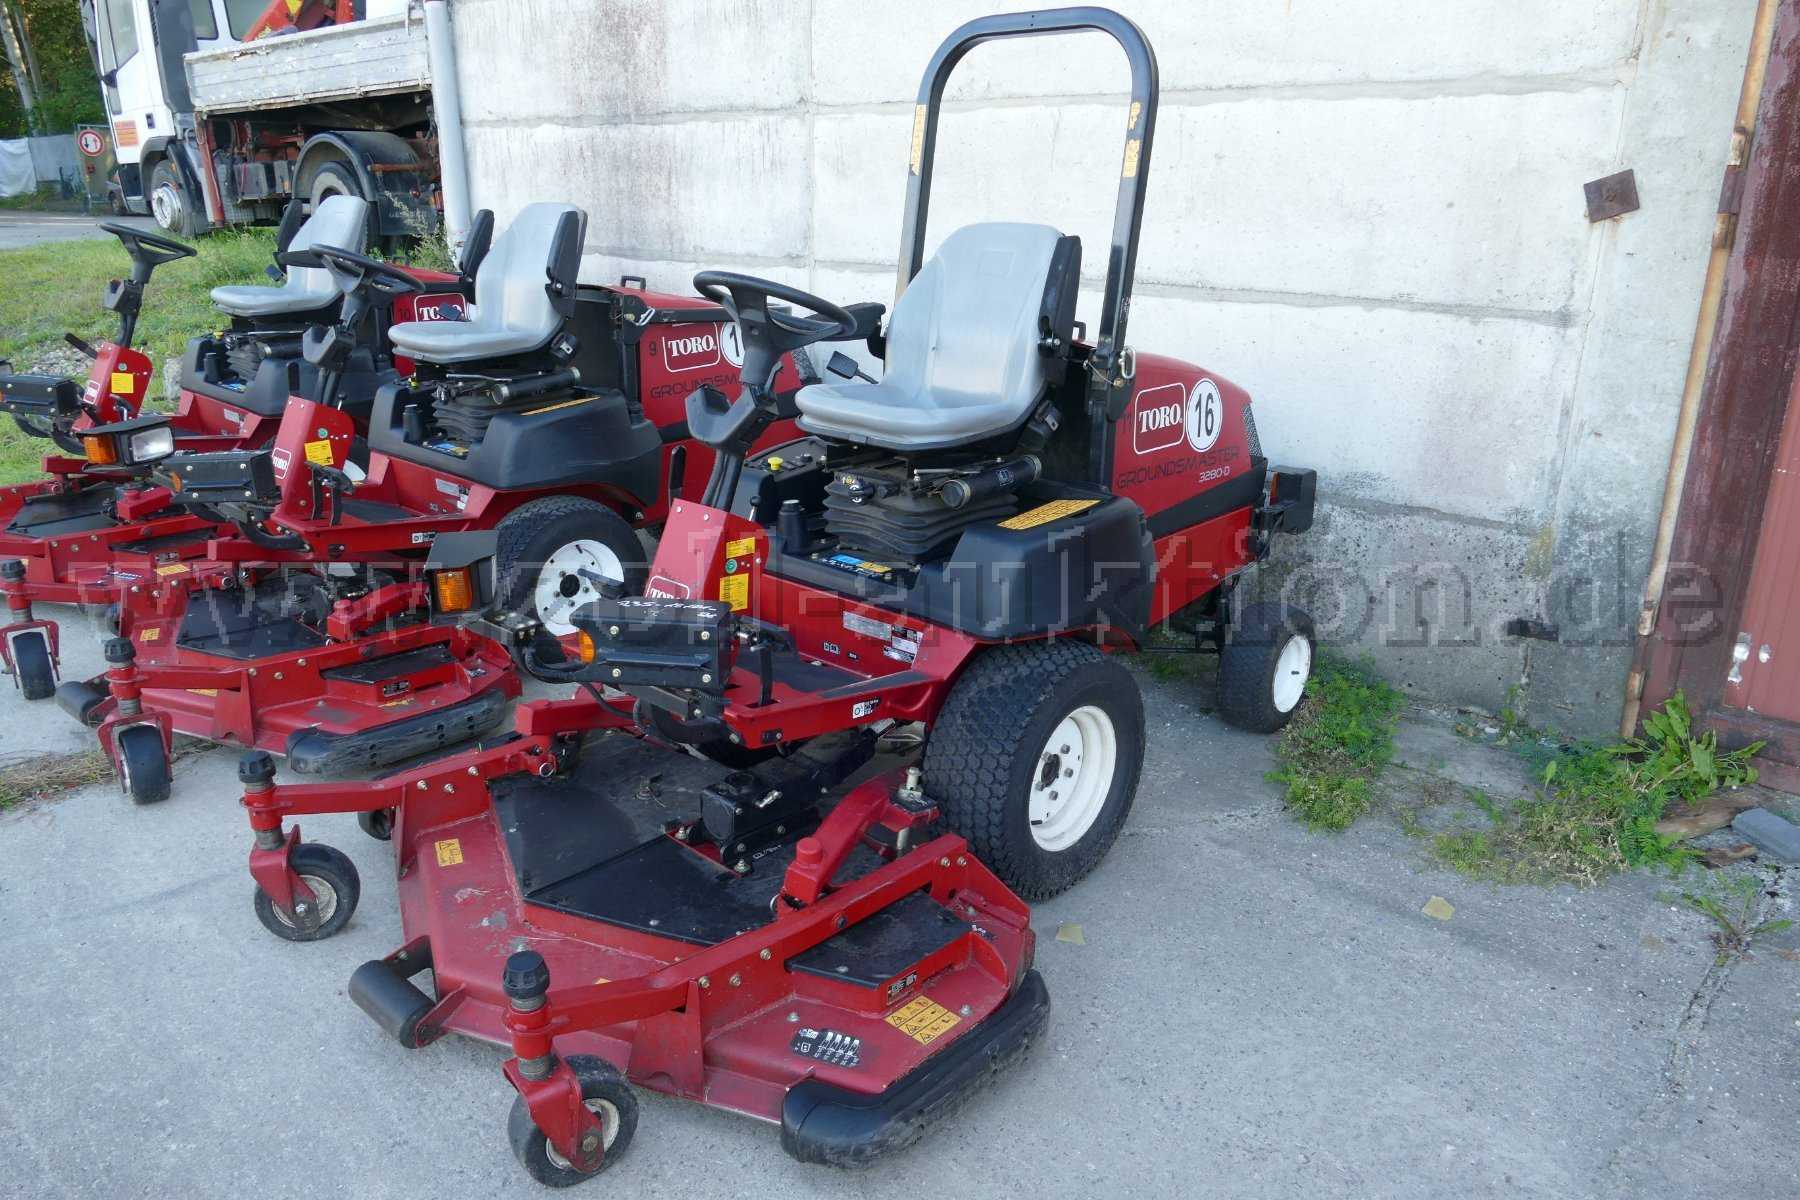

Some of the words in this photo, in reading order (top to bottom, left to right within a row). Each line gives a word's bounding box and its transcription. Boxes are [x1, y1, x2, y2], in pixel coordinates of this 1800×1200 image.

[420, 305, 463, 321] TO
[668, 334, 715, 357] TORO
[650, 373, 743, 400] GROUNDSM
[1138, 403, 1182, 434] TORO
[1194, 392, 1215, 438] 16
[1117, 446, 1240, 490] GROUNDSMASTER
